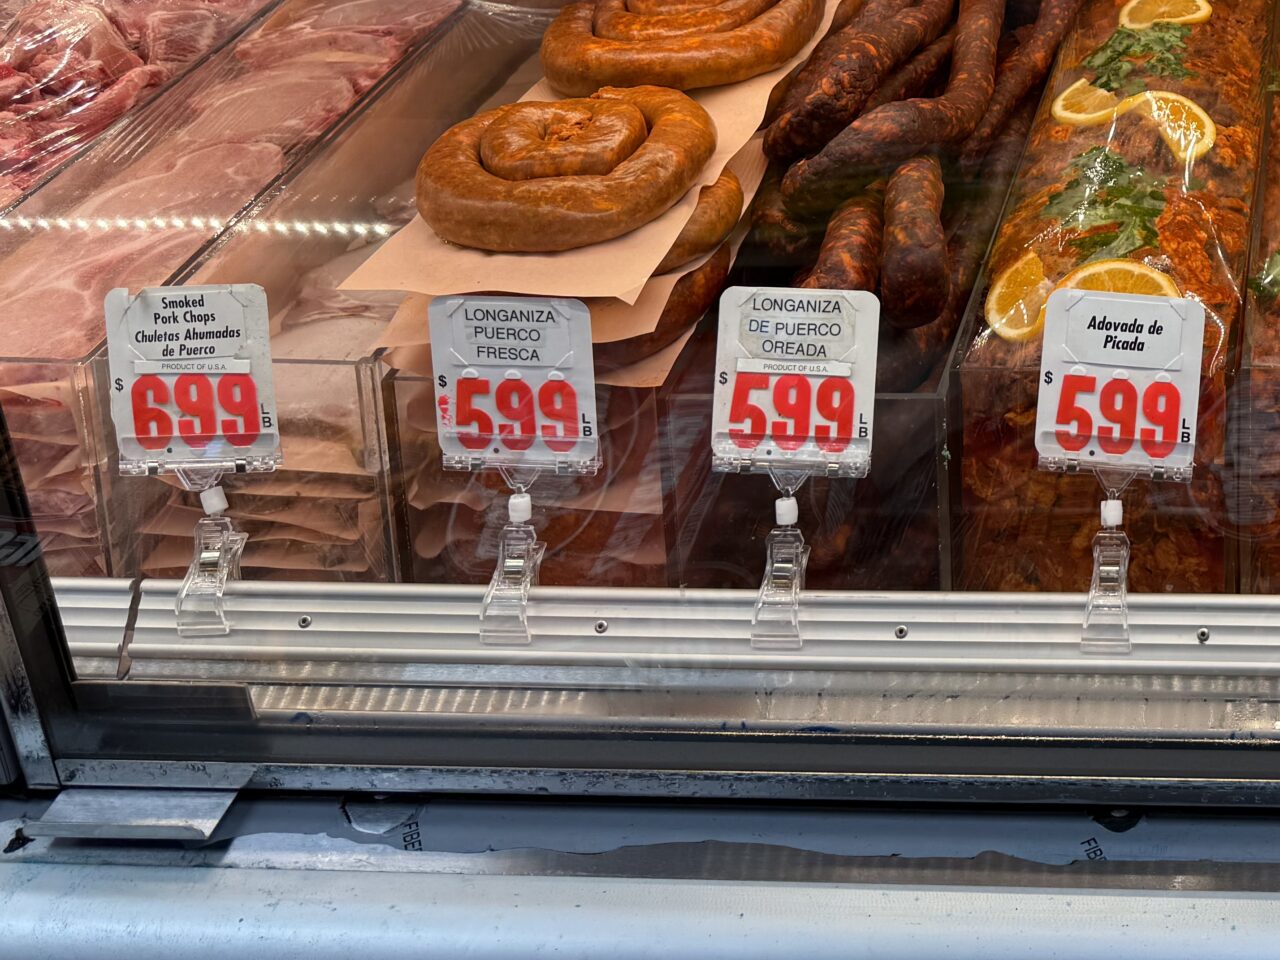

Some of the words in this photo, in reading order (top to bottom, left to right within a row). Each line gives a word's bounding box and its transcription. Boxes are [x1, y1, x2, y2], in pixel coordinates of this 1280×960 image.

[161, 294, 205, 310] Smoked
[752, 298, 842, 313] LONGANIZA
[153, 311, 179, 325] Pork
[183, 310, 216, 327] Chops
[464, 308, 556, 323] LONGANIZA
[749, 319, 769, 333] DE
[775, 322, 841, 336] PUERCO
[1087, 315, 1144, 334] Adovada
[1148, 320, 1163, 335] de
[135, 330, 180, 343] Chuletas
[184, 326, 241, 341] Ahumadas
[474, 326, 541, 341] PUERCO
[162, 344, 175, 358] de
[179, 344, 216, 357] Puerco
[762, 340, 827, 357] OREADA
[1103, 335, 1145, 352] Picada
[477, 346, 540, 361] FRESCA
[763, 363, 797, 372] PRODUCT
[402, 820, 422, 851] FIBE
